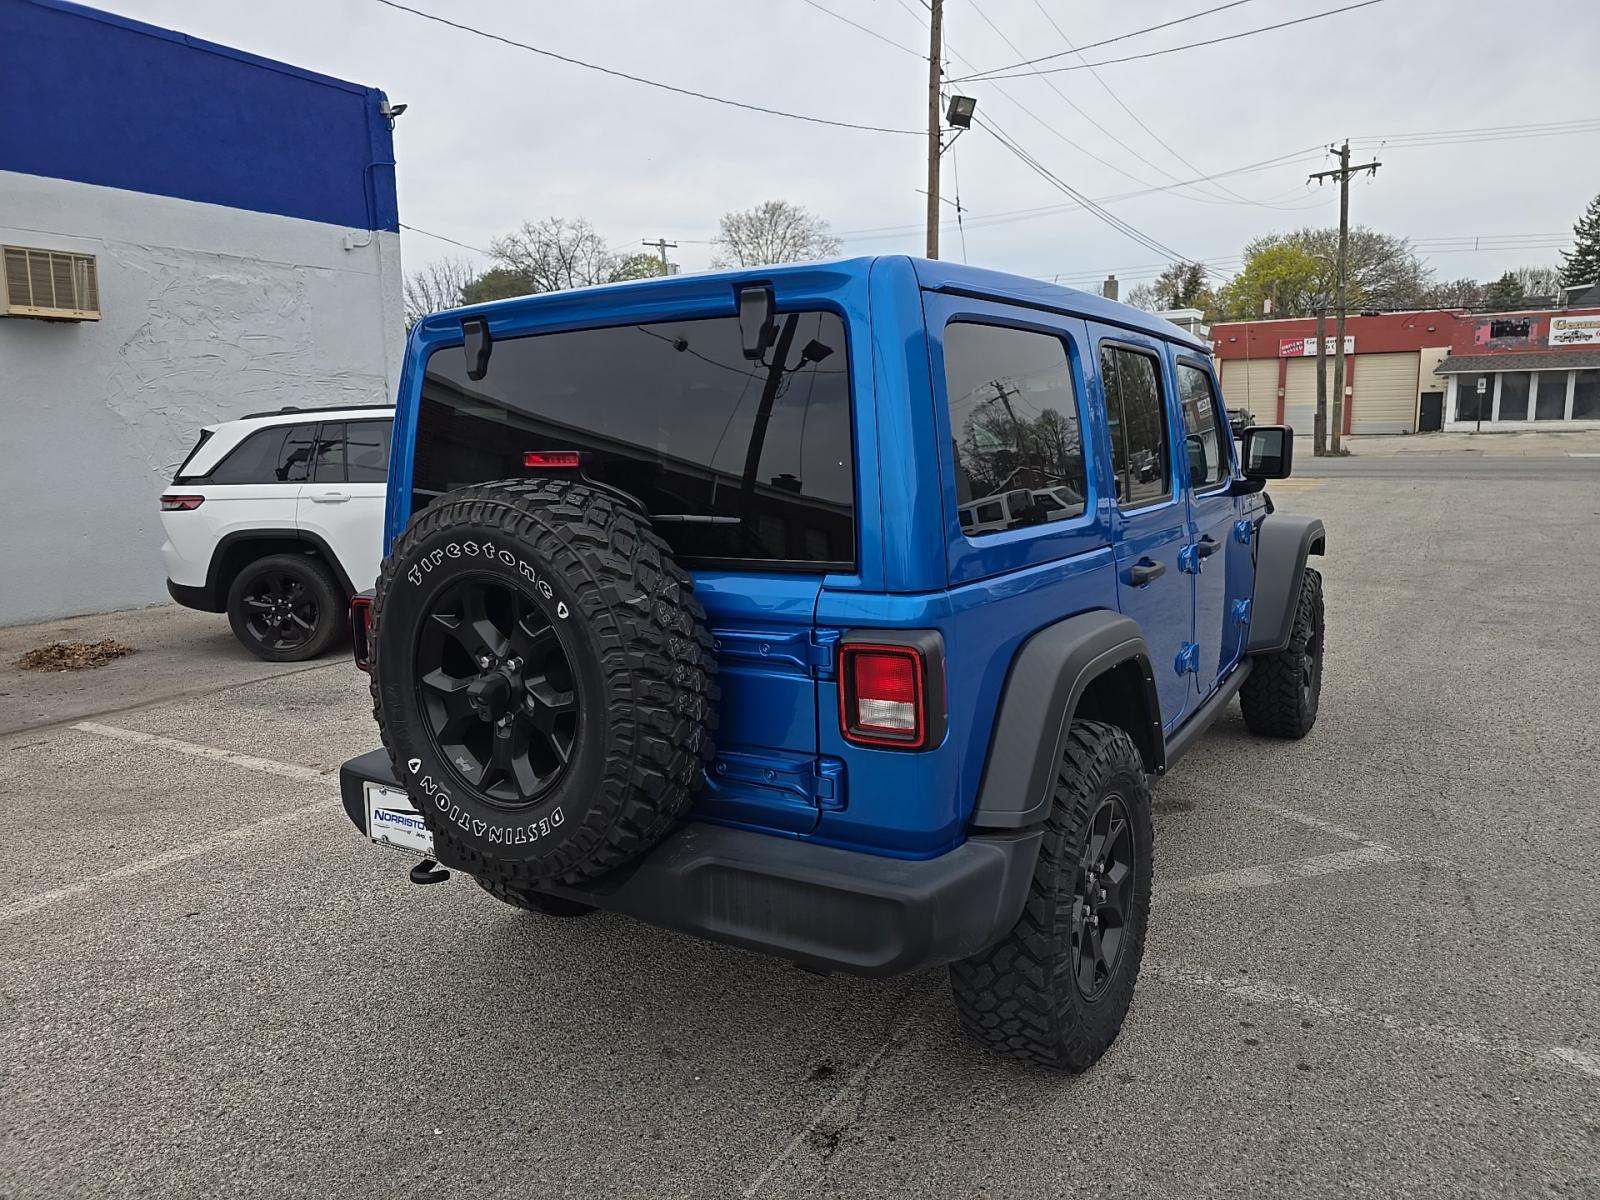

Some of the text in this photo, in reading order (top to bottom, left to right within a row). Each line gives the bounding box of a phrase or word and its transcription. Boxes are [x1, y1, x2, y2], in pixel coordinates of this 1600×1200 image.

[408, 541, 553, 599] Firestone
[374, 810, 428, 831] NORRISTO
[420, 776, 565, 845] DESTINATION
